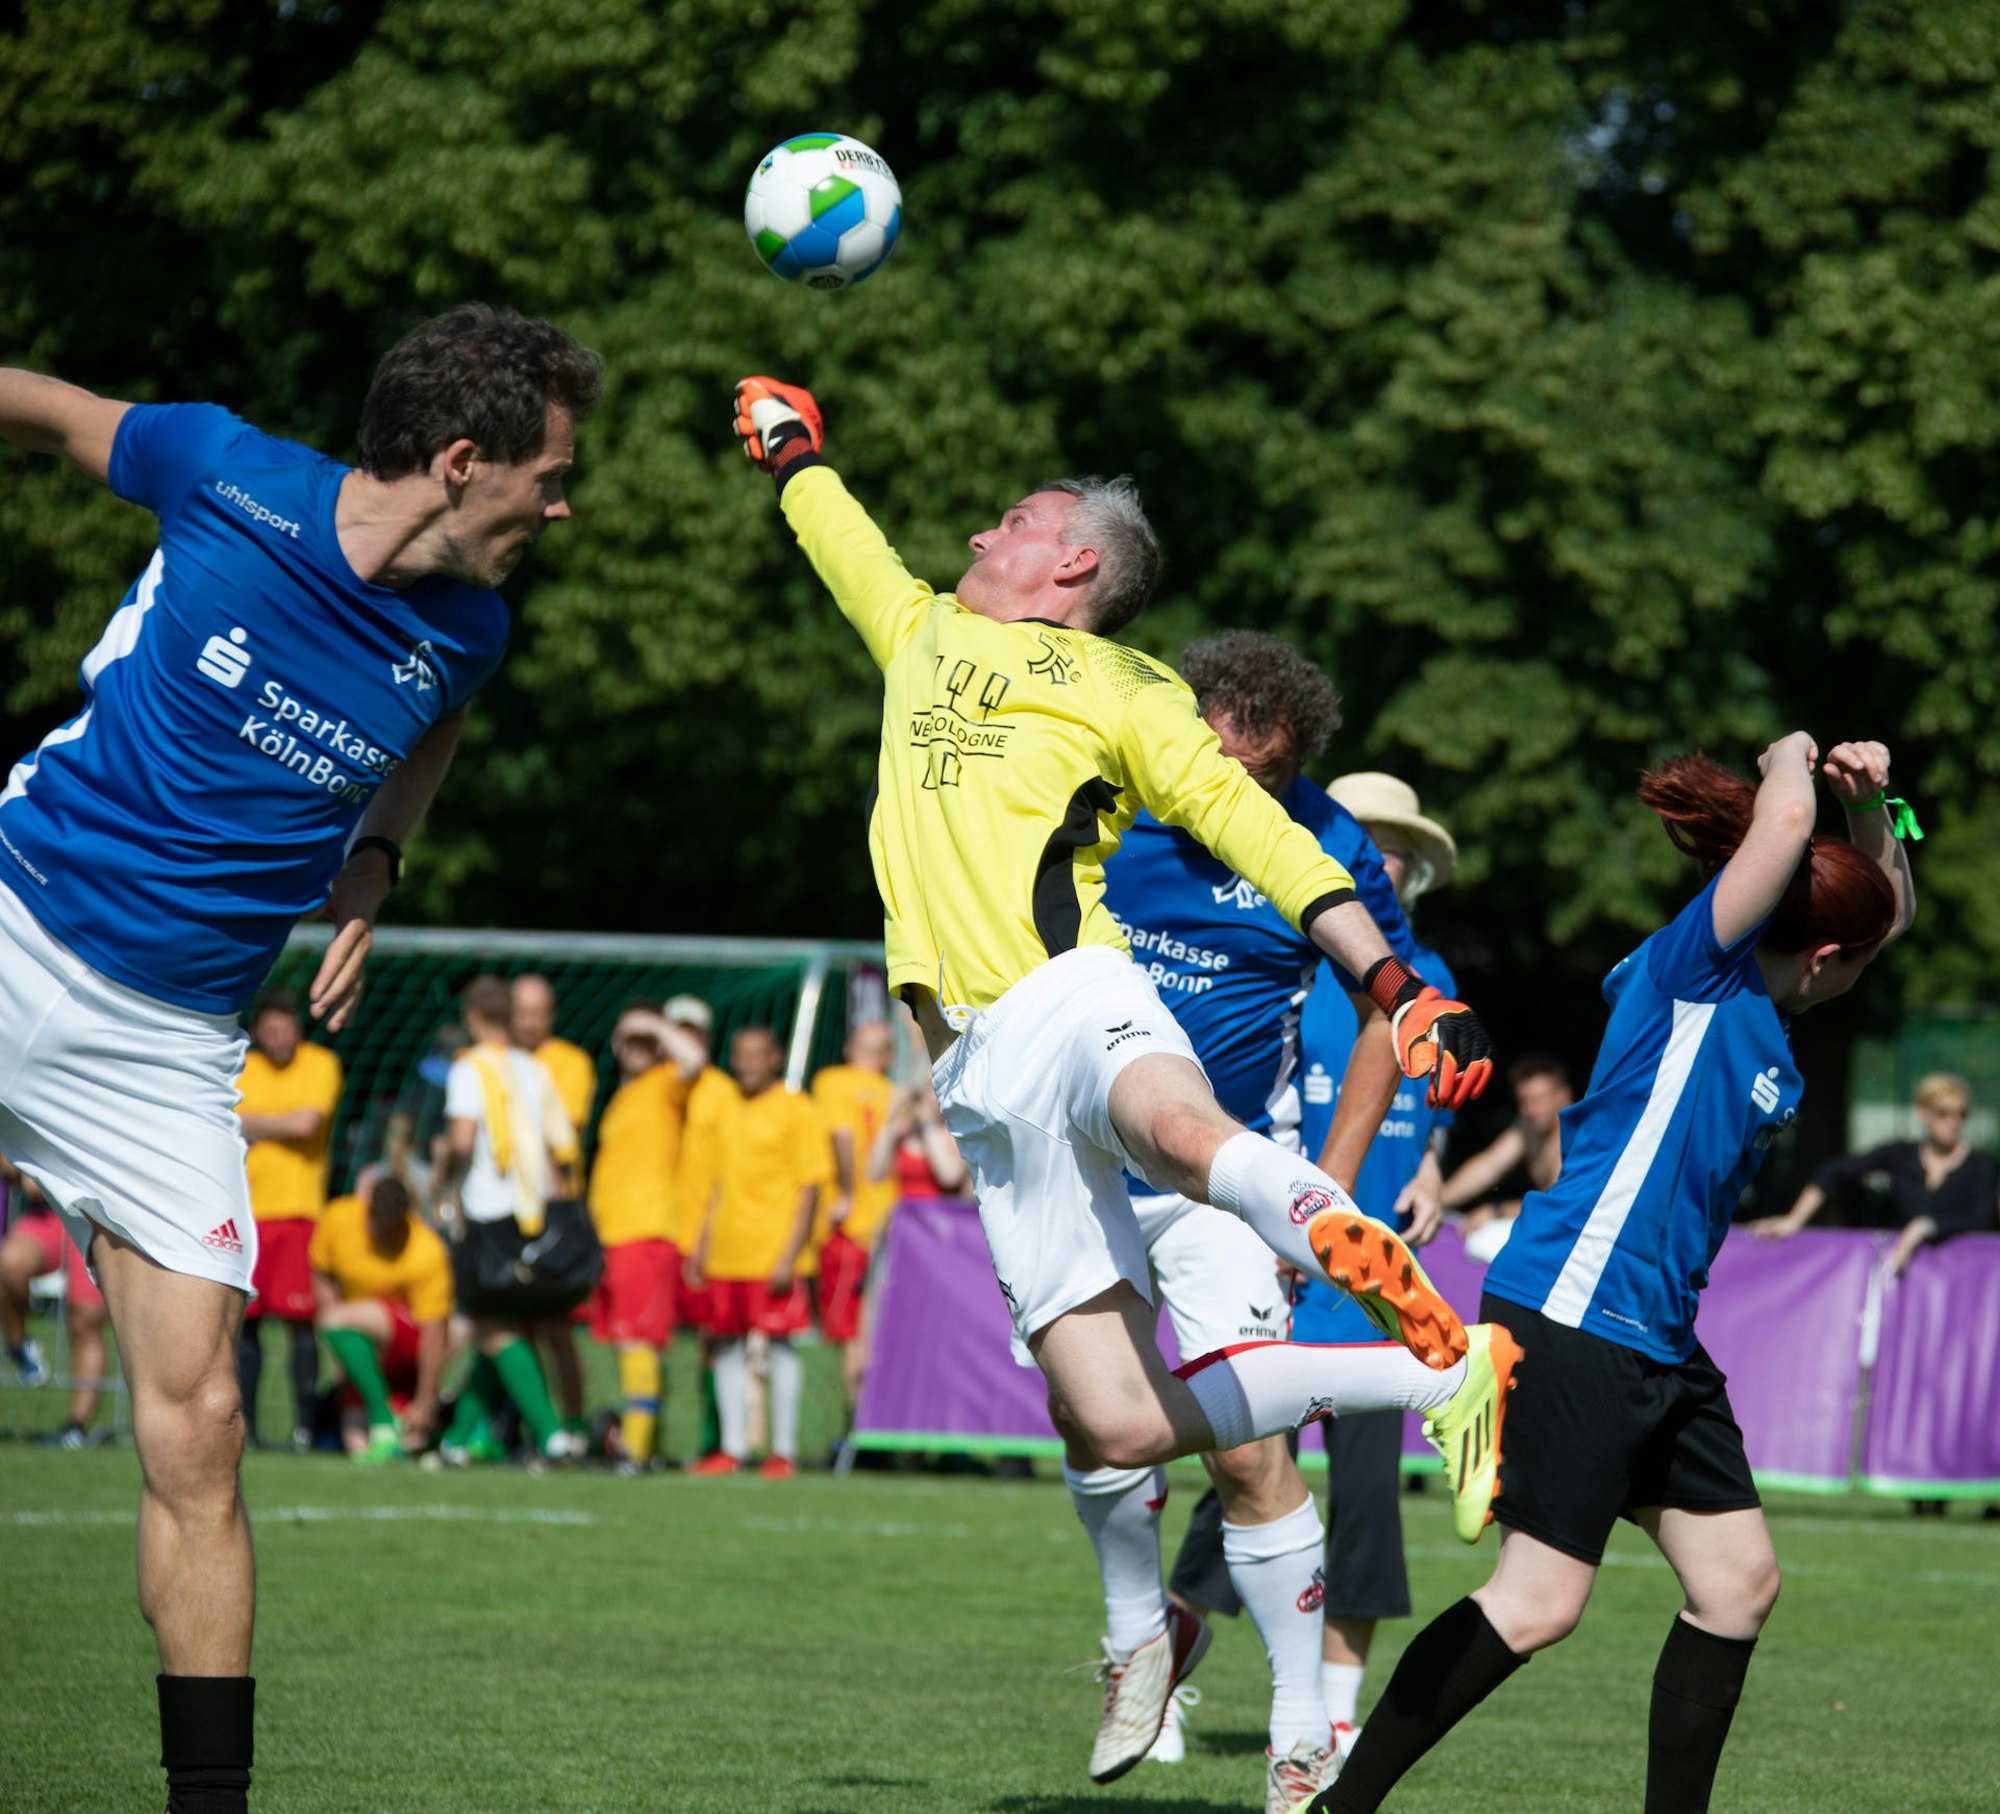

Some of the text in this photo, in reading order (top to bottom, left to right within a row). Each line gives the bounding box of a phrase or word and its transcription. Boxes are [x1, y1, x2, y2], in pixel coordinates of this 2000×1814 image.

[834, 150, 889, 175] DERBY
[215, 481, 301, 538] uhlsport
[257, 681, 399, 776] Sparkasse
[930, 715, 1008, 749] OLOGNE
[1110, 911, 1230, 972] parkasse
[1132, 961, 1213, 994] Bonn
[1106, 1030, 1151, 1052] erima
[202, 1235, 243, 1254] adidas
[1238, 1325, 1277, 1340] erima
